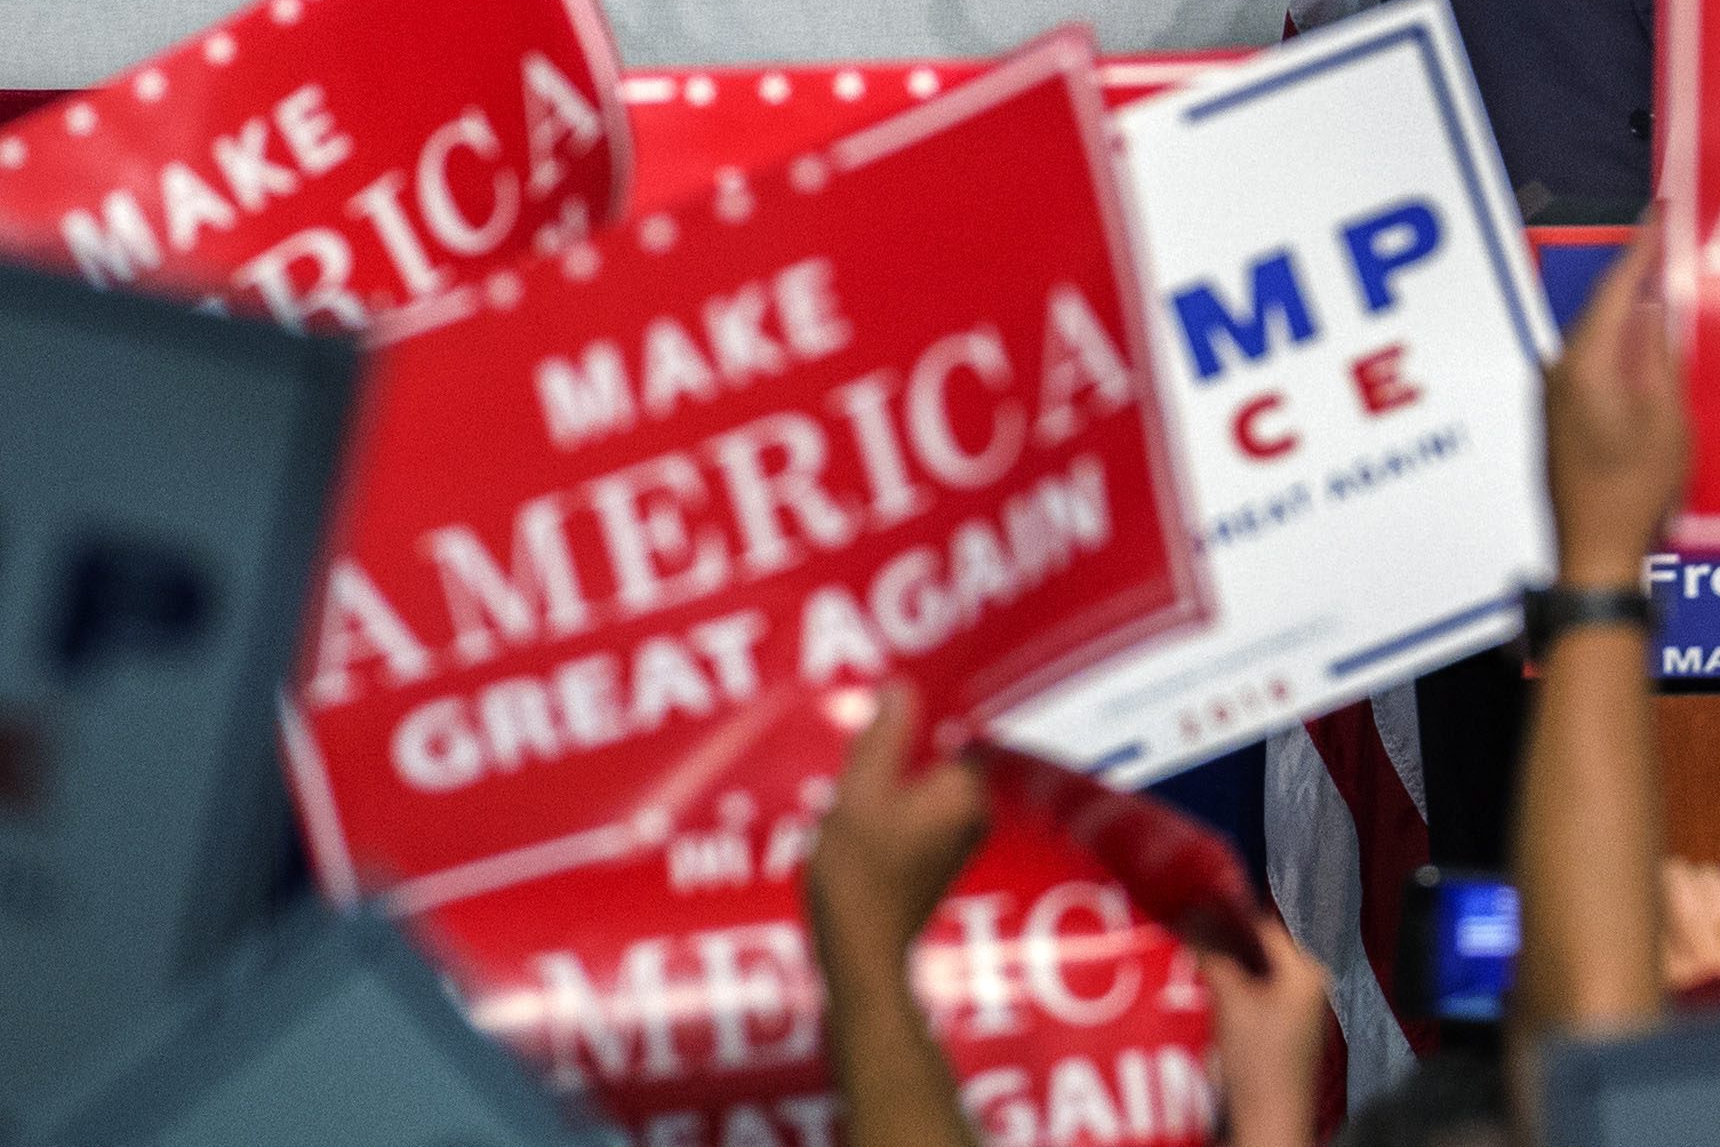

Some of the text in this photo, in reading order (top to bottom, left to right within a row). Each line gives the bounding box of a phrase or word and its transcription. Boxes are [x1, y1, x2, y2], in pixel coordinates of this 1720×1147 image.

[62, 85, 354, 289] MAKE
[230, 50, 604, 335] RICA
[535, 263, 855, 451] MAKE
[1170, 198, 1450, 385] MP
[308, 283, 1132, 711] AMERICA
[1228, 341, 1424, 461] CE
[390, 610, 770, 793] GREAT
[800, 461, 1112, 683] AGAIN
[958, 1043, 1222, 1147] GAIN
